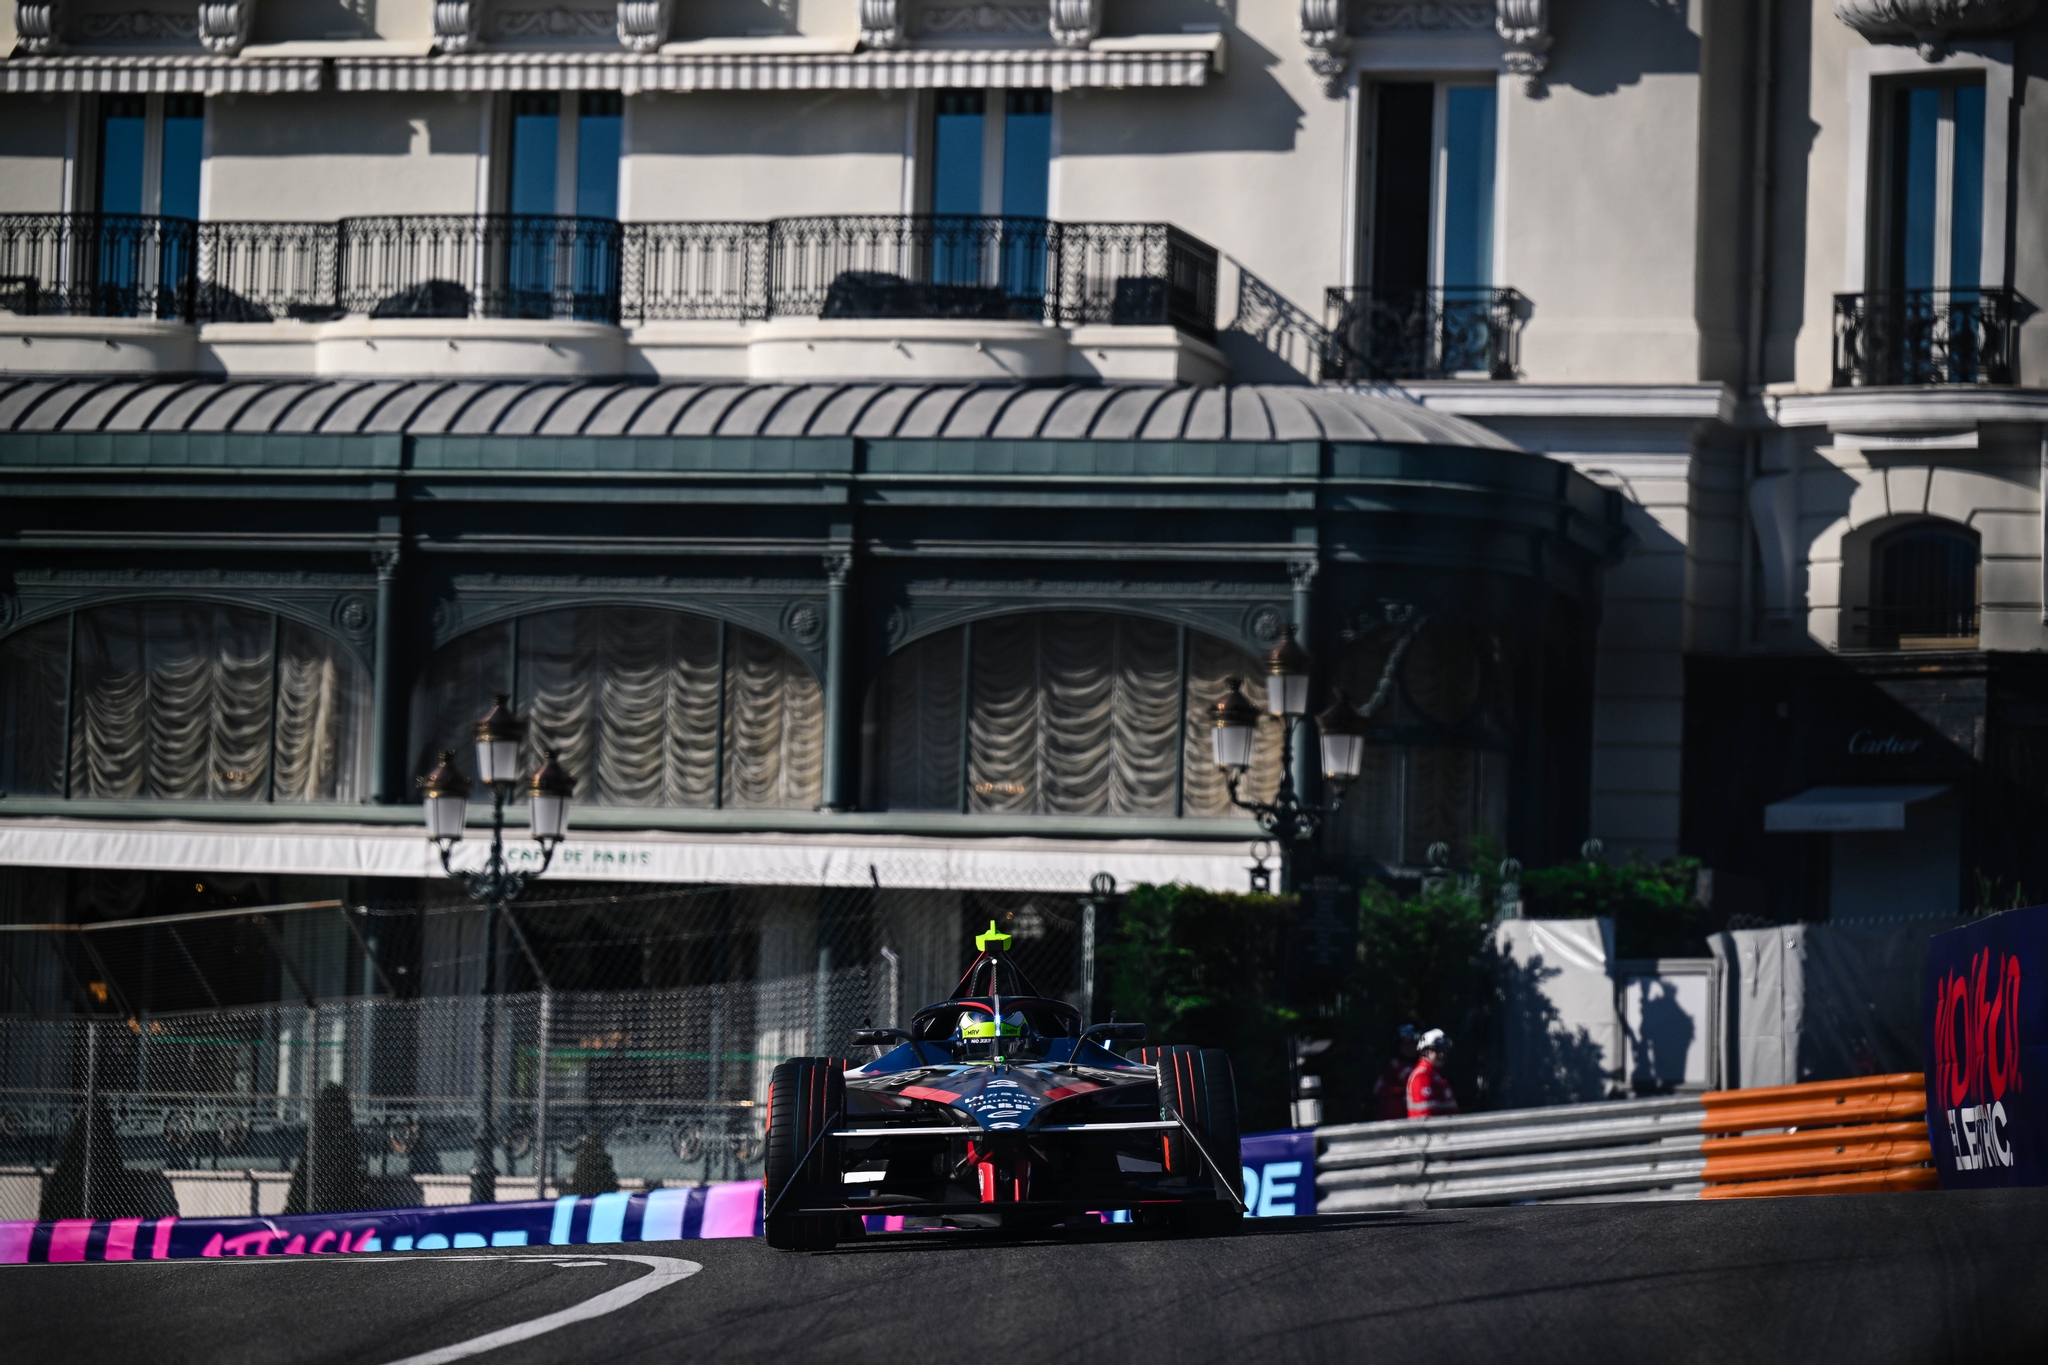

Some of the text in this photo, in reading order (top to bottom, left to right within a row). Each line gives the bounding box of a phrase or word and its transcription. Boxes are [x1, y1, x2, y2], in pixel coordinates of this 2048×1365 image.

[1849, 728, 1924, 755] Cartier
[563, 851, 582, 864] DE
[593, 852, 652, 866] PARIS
[976, 1102, 1031, 1112] ABB
